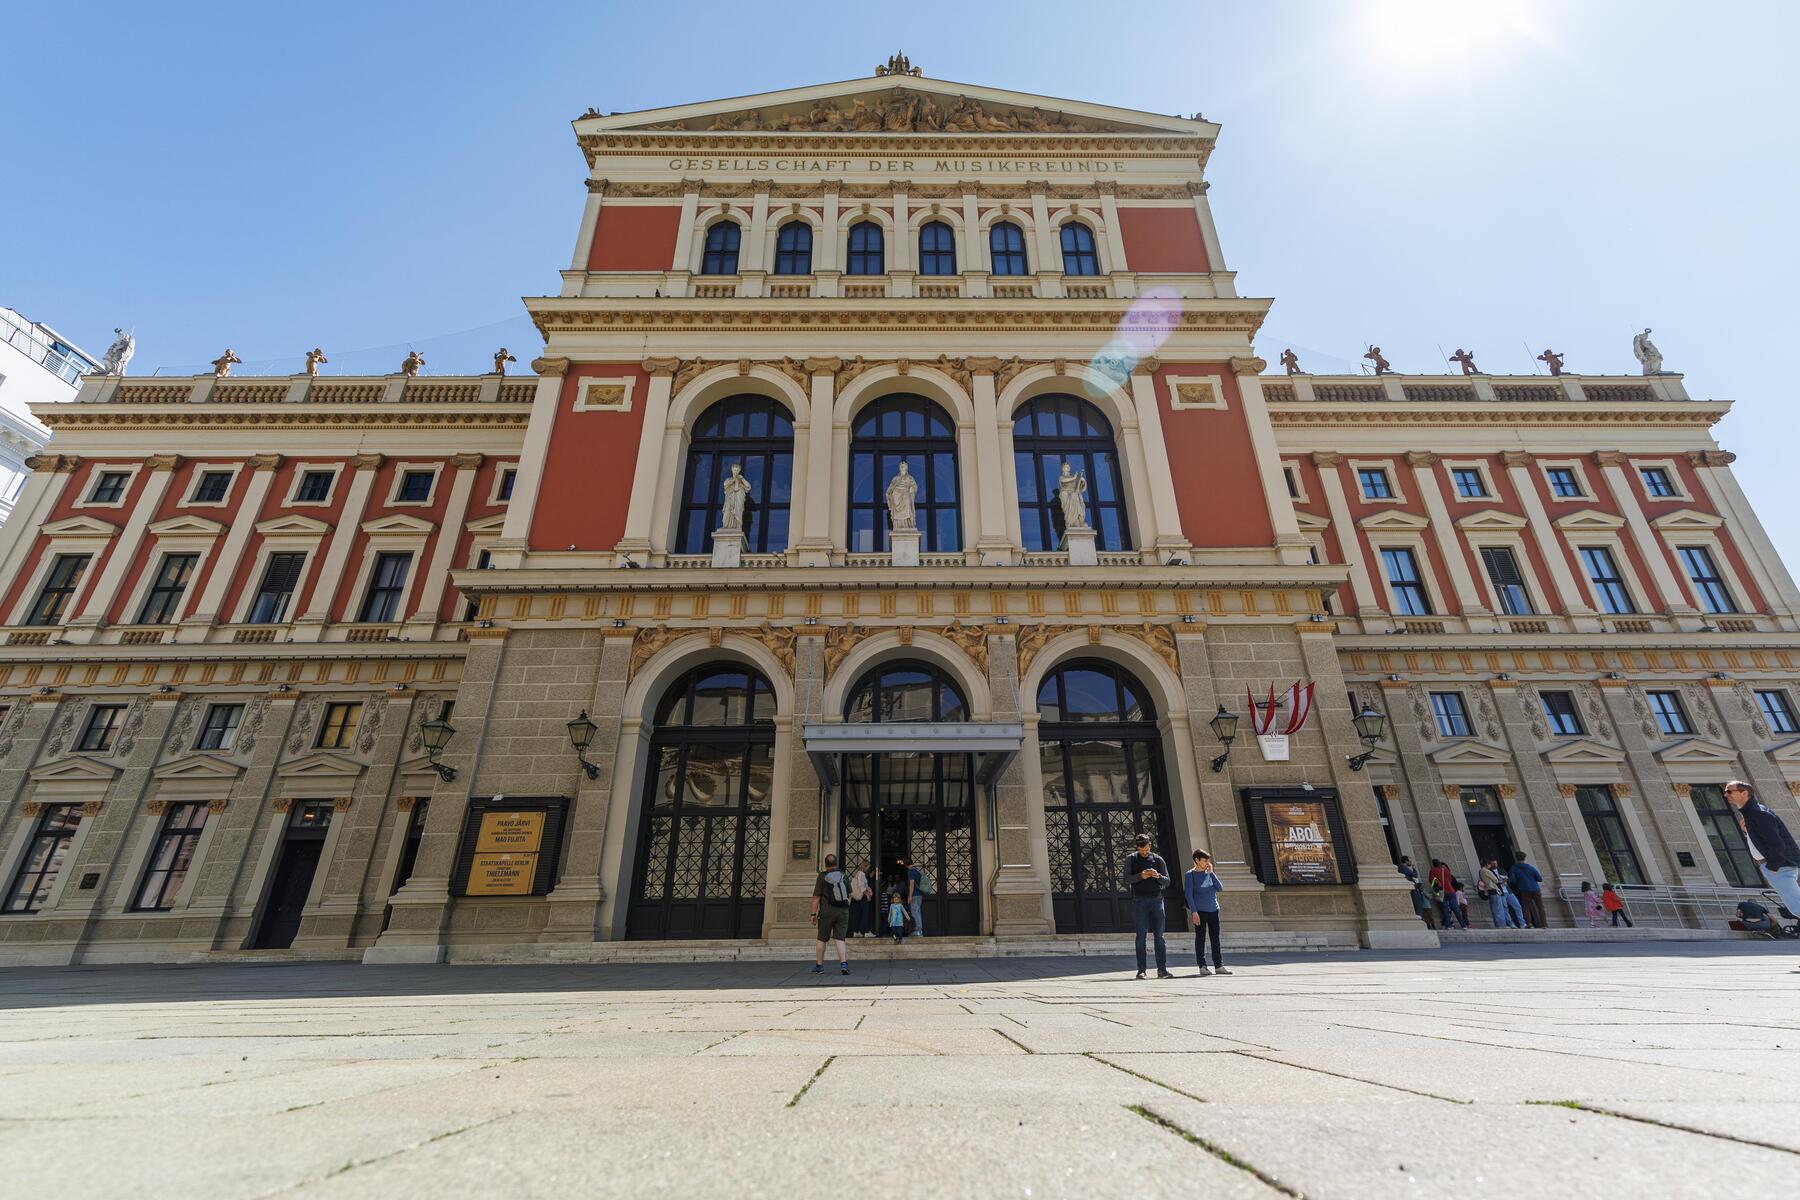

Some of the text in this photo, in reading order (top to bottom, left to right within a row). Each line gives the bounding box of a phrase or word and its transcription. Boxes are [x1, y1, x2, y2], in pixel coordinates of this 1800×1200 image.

[668, 159, 1126, 173] GESELLSCHAFT DER MUSIKFREUNDE
[1289, 827, 1313, 842] ABO
